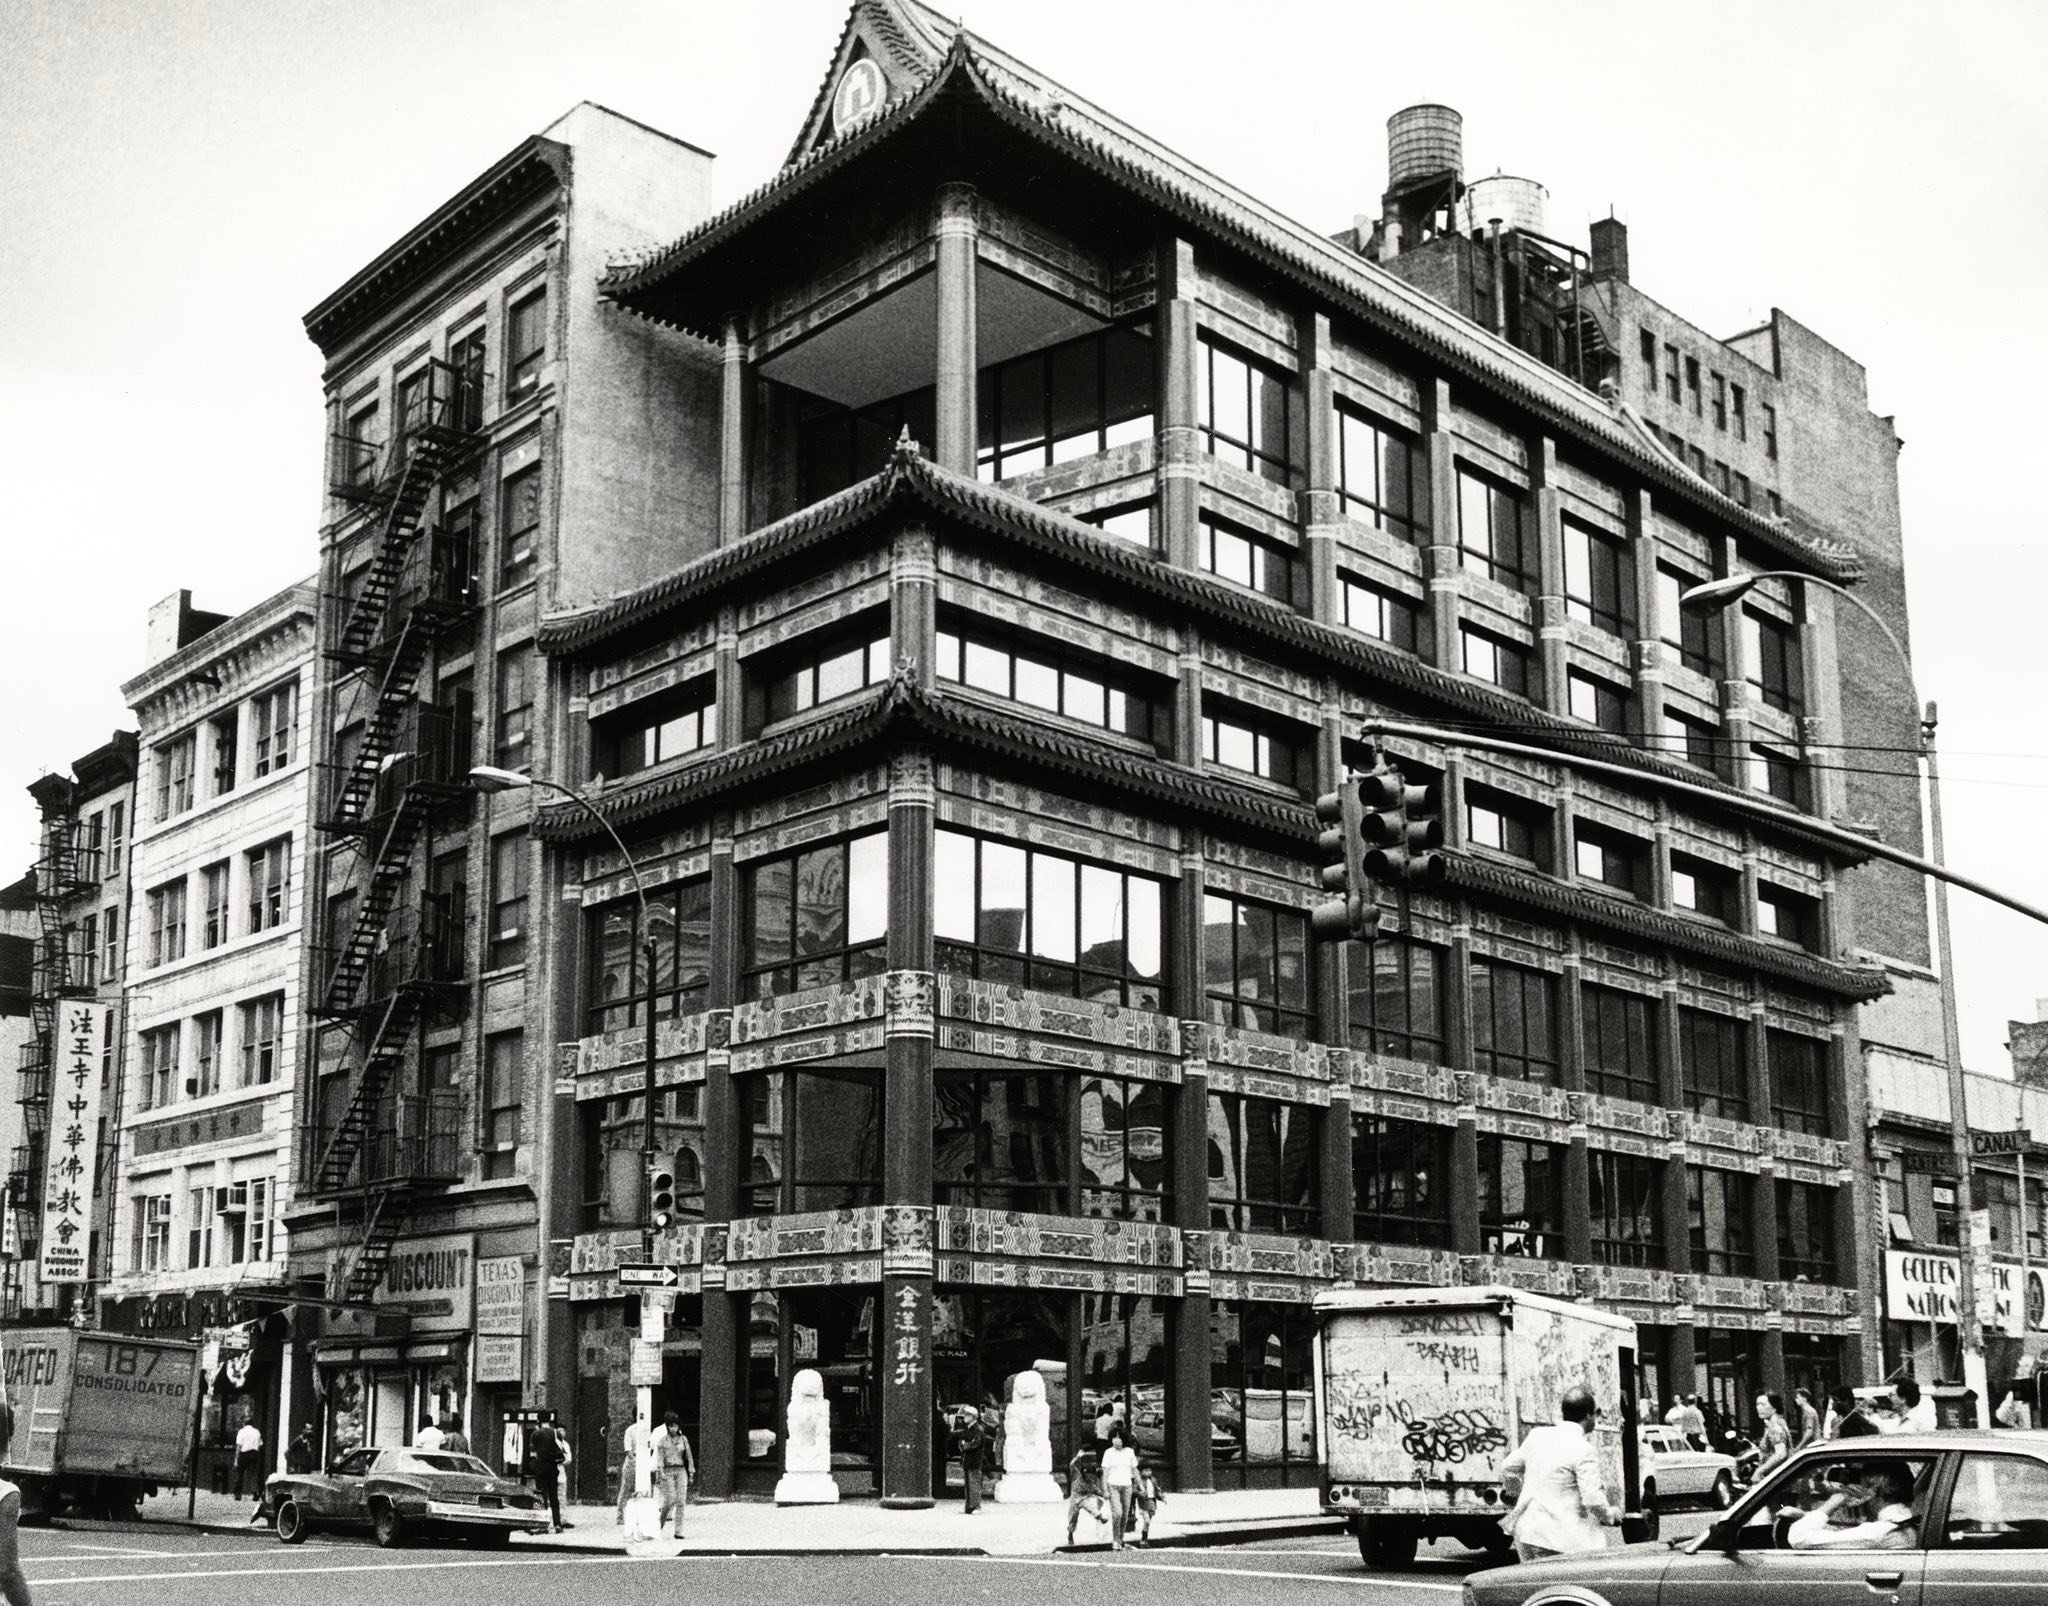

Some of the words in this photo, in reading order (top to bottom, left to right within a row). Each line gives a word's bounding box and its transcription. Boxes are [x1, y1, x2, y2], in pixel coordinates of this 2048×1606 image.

[1974, 1134, 2019, 1154] CANAL
[51, 1247, 79, 1256] CHINA
[388, 1249, 468, 1293] DISCOUNT
[481, 1261, 518, 1282] TEXAS
[623, 1269, 641, 1280] ONE
[652, 1271, 670, 1280] WAY
[1902, 1257, 1956, 1285] GOLDEN
[479, 1282, 522, 1305] DISCOUNTS
[104, 1344, 162, 1377] 187
[75, 1374, 185, 1397] CONSOLIDATED
